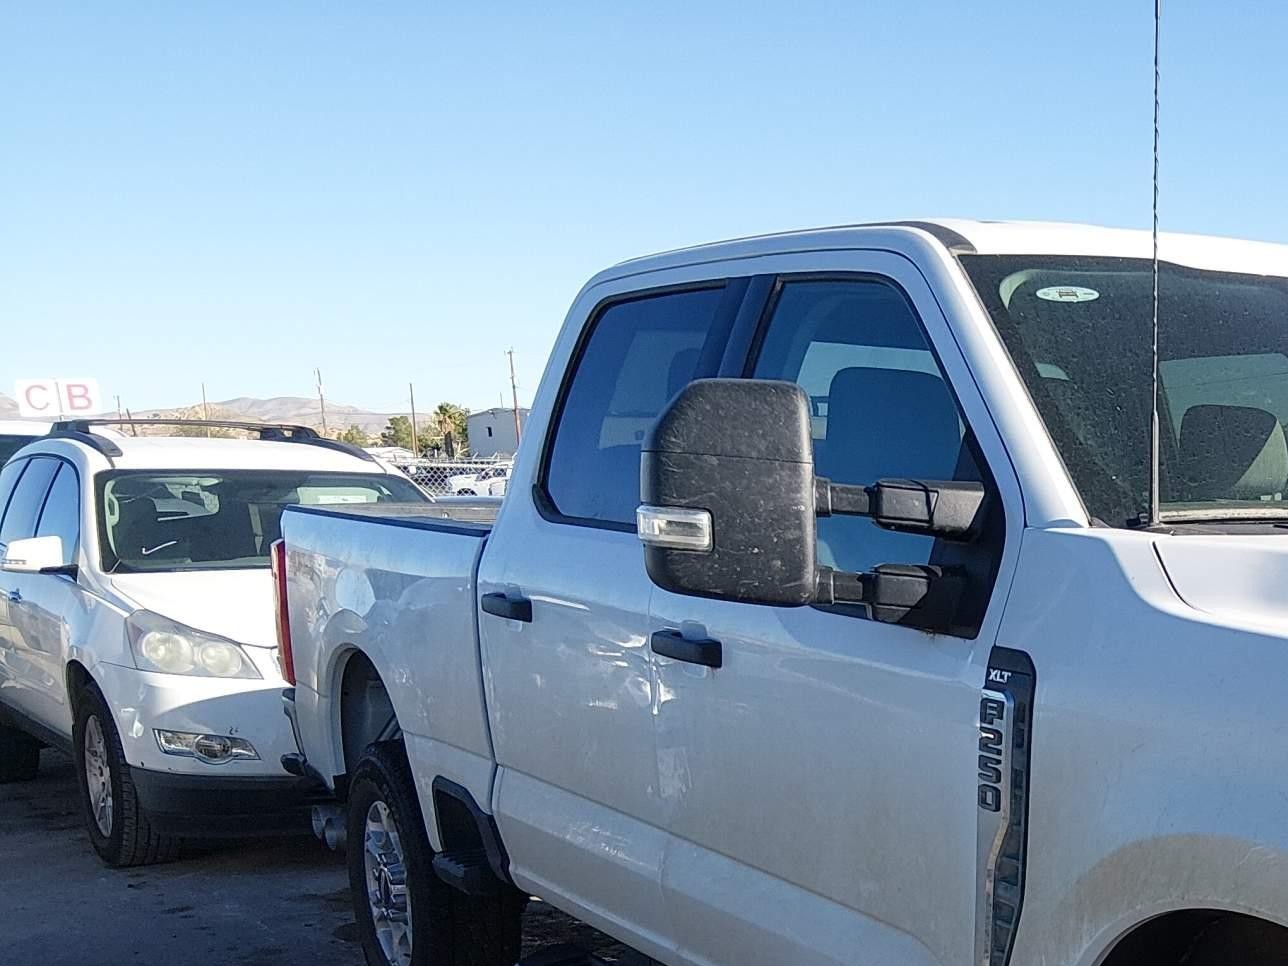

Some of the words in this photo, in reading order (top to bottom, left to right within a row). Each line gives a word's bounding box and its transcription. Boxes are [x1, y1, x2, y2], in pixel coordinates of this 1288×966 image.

[24, 384, 50, 411] C
[65, 383, 93, 411] B
[987, 667, 1012, 684] XLT
[977, 697, 1005, 813] F250
